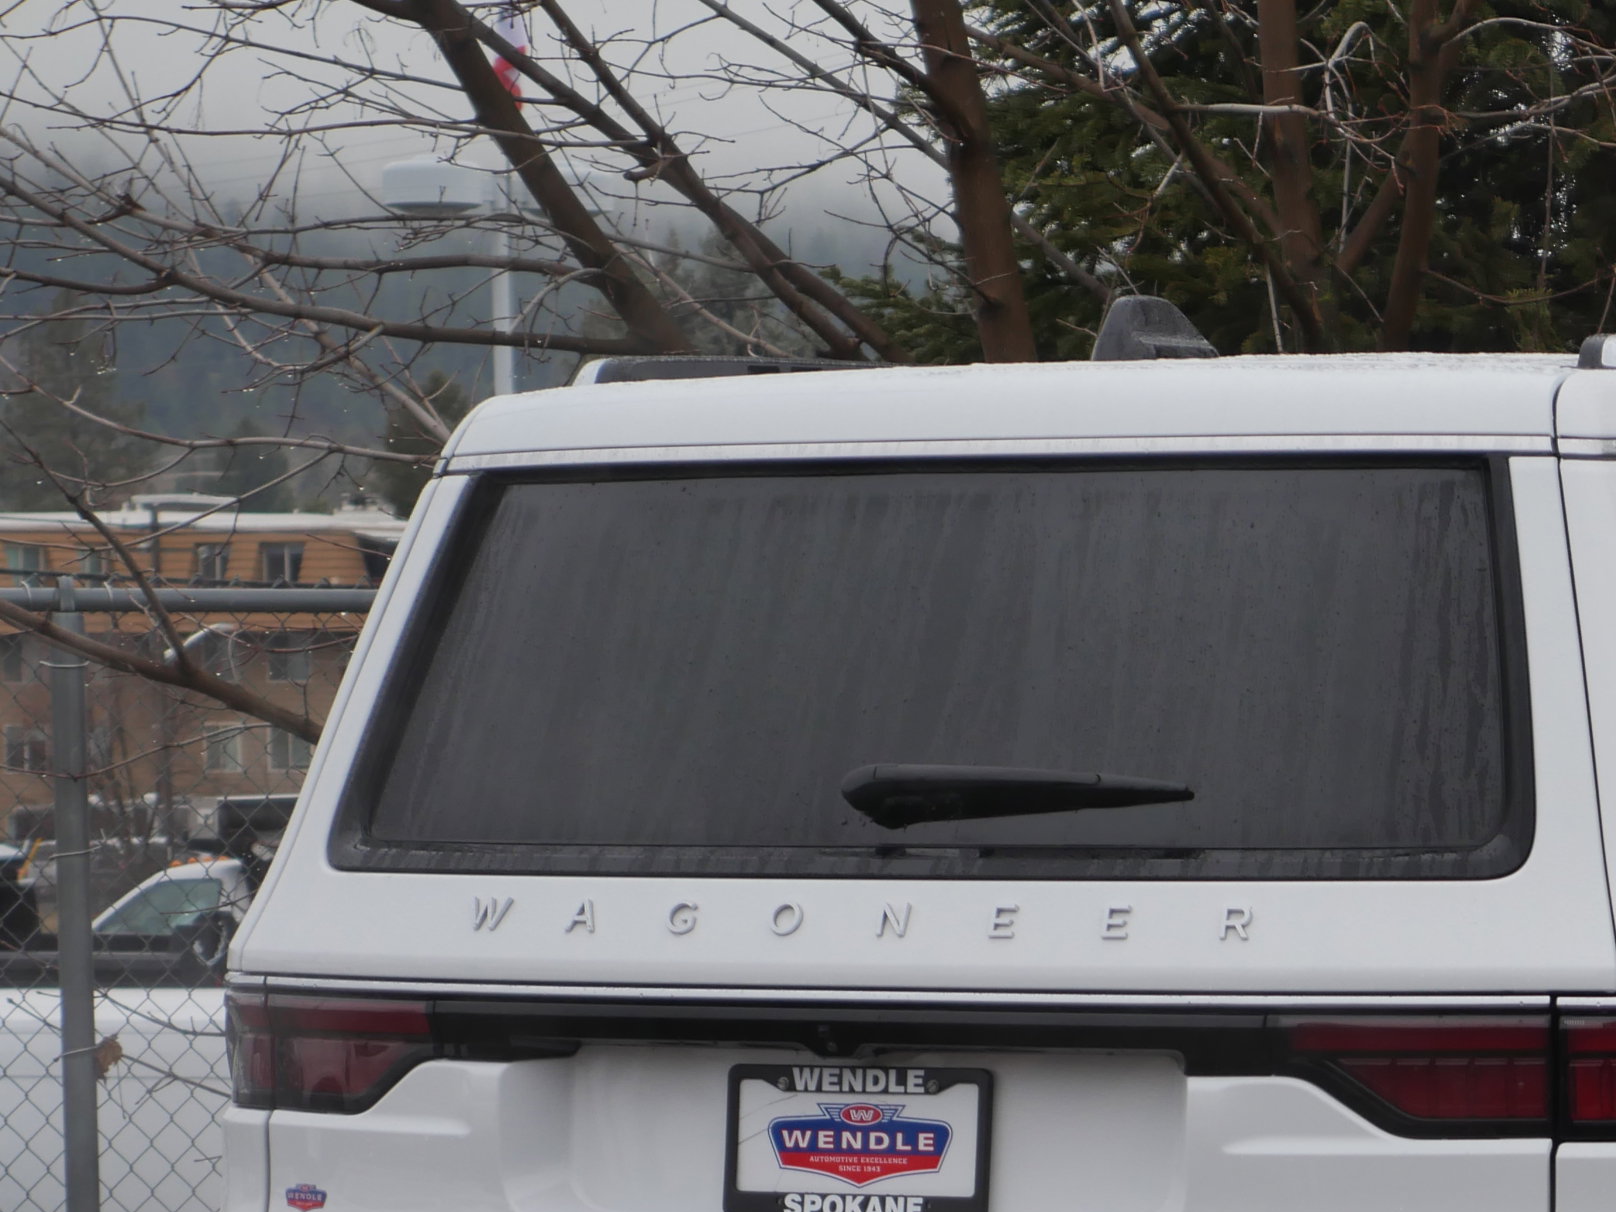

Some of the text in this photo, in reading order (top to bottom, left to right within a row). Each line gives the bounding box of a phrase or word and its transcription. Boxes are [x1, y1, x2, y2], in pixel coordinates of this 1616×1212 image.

[473, 895, 1254, 941] WAGONEER
[792, 1067, 926, 1094] WENDLE
[782, 1129, 935, 1152] WENDLE
[809, 1155, 908, 1165] AUTOMOTIVE EXCELLENCE
[287, 1192, 323, 1201] WENDLE
